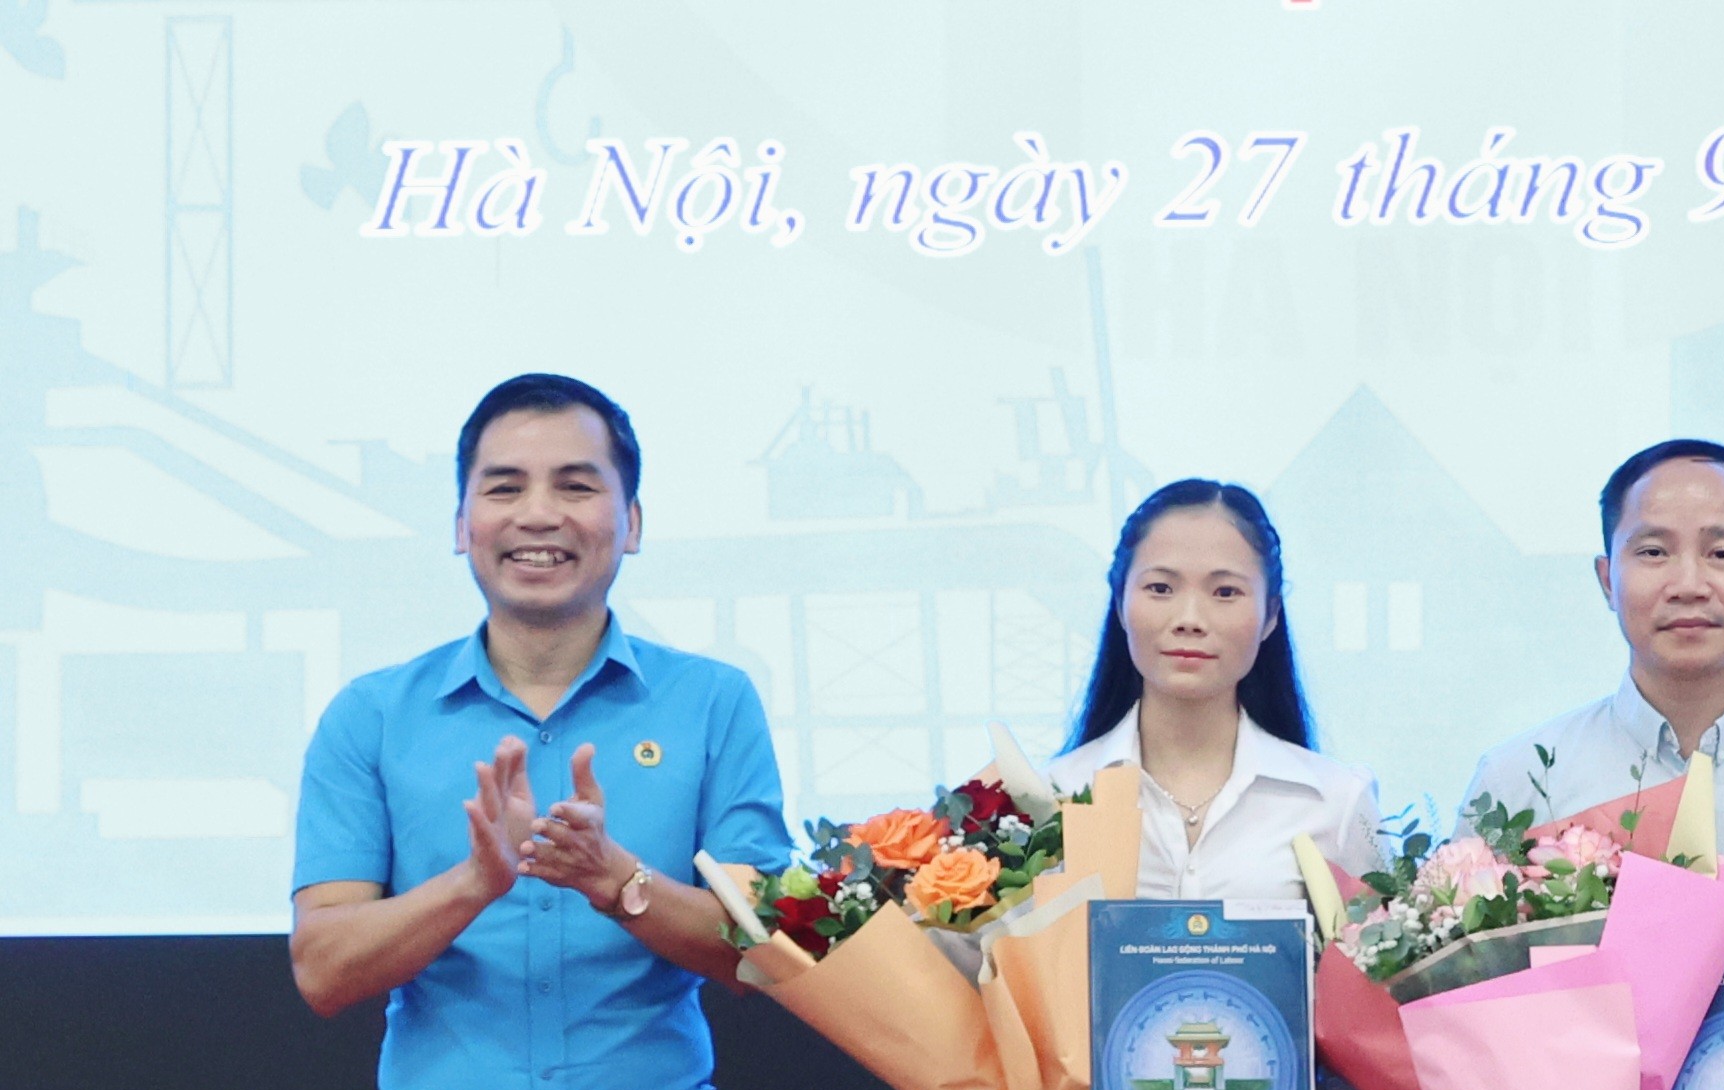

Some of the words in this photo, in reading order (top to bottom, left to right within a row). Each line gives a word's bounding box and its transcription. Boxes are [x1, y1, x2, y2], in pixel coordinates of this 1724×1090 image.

[366, 139, 542, 234] Hà
[569, 141, 801, 249] Nội,
[850, 135, 1125, 255] ngày
[1157, 133, 1303, 223] 27
[1336, 129, 1660, 247] tháng
